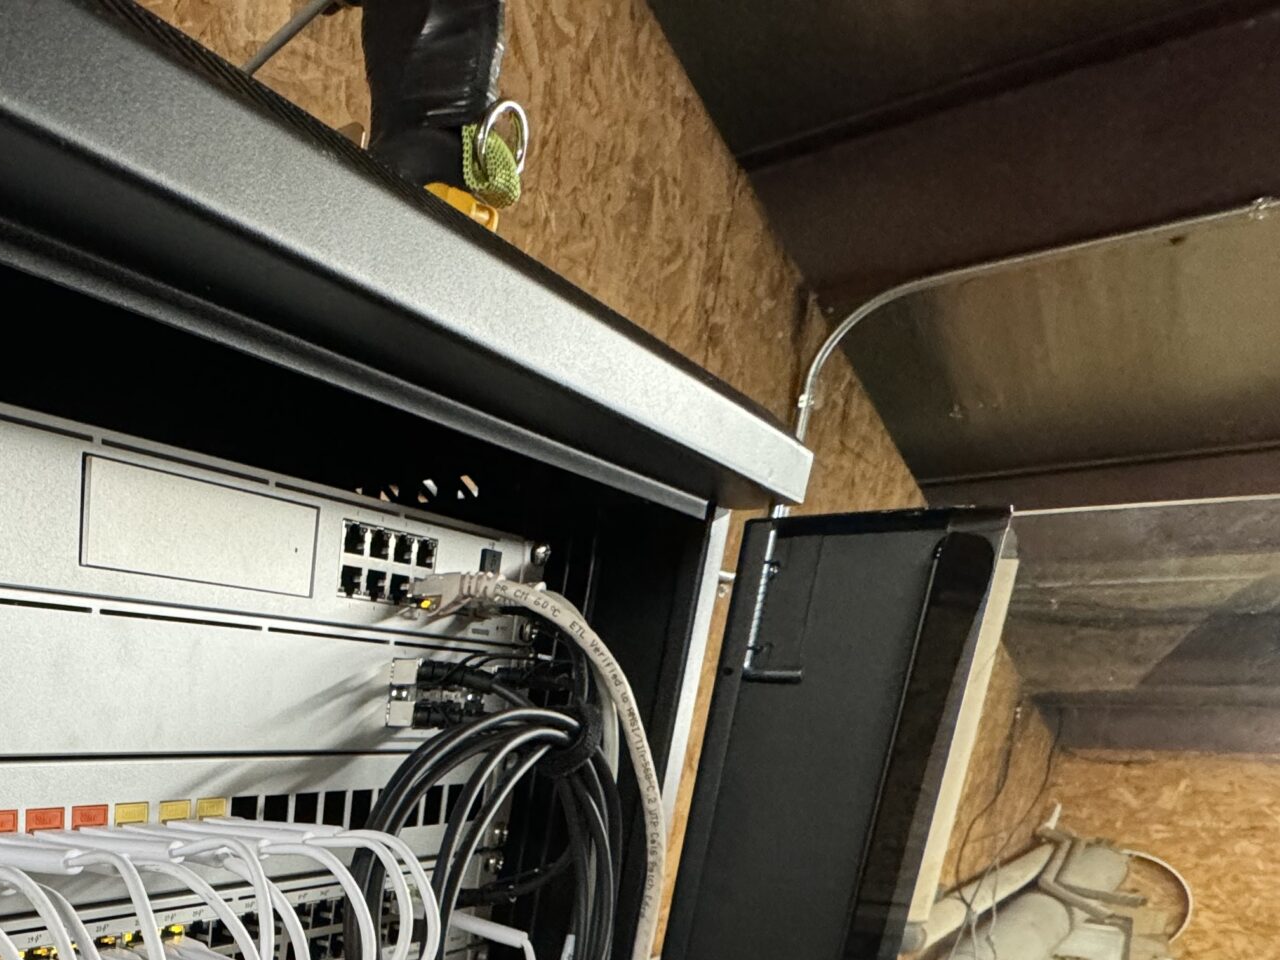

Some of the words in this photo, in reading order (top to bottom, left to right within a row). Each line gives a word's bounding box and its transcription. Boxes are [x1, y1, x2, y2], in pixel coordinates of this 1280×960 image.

[568, 619, 587, 640] ETL
[589, 638, 624, 687] Verified
[647, 808, 660, 828] UTP
